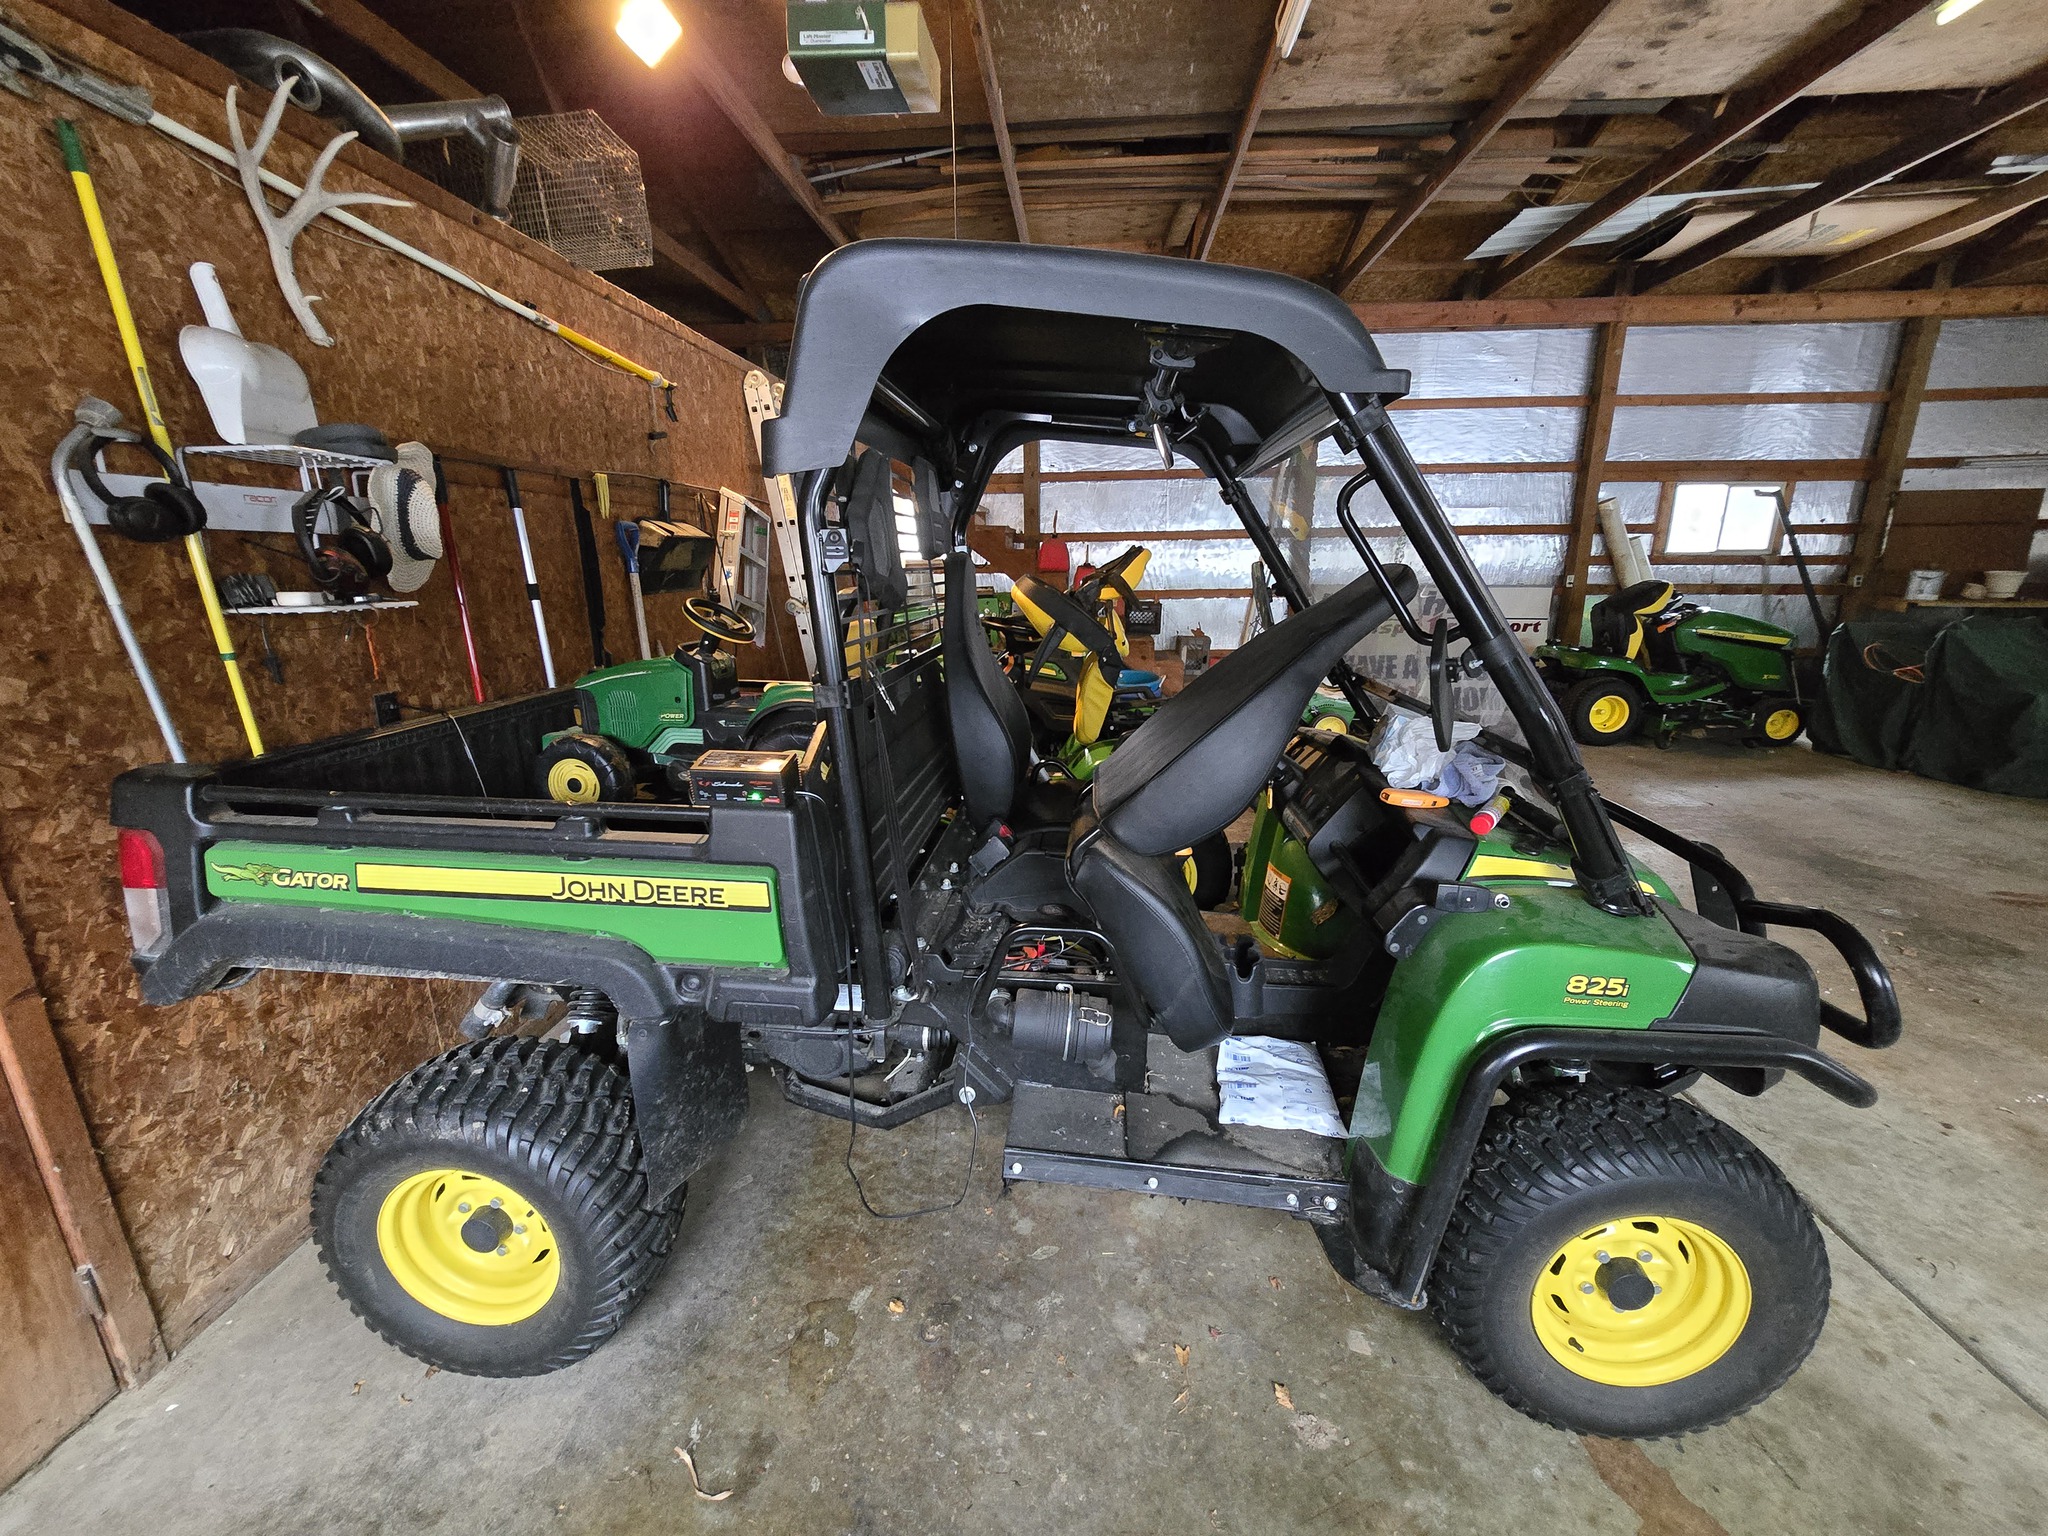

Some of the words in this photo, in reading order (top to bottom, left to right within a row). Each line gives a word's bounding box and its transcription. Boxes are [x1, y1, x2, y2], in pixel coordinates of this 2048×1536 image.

[272, 868, 349, 891] GATOR
[552, 876, 626, 900] JOHN
[633, 880, 725, 905] DEERE
[1566, 974, 1630, 997] 825i
[1563, 996, 1591, 1006] Power
[1592, 998, 1630, 1009] Steering
